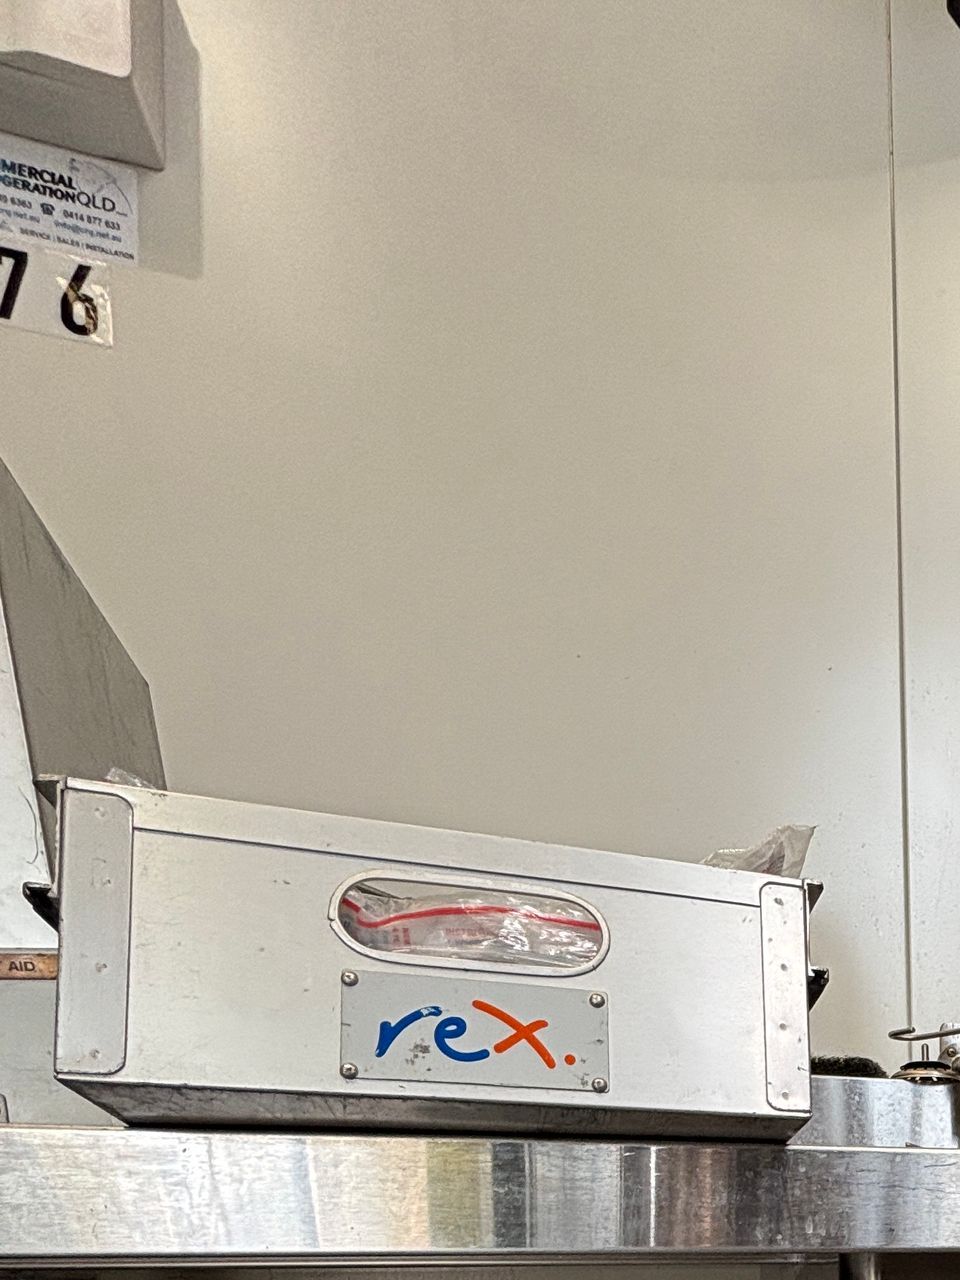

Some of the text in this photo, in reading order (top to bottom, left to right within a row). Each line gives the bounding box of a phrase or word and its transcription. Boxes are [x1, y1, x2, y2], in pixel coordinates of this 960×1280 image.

[0, 174, 116, 213] GERATIONQLD
[63, 209, 85, 222] 0414
[8, 961, 36, 972] AID
